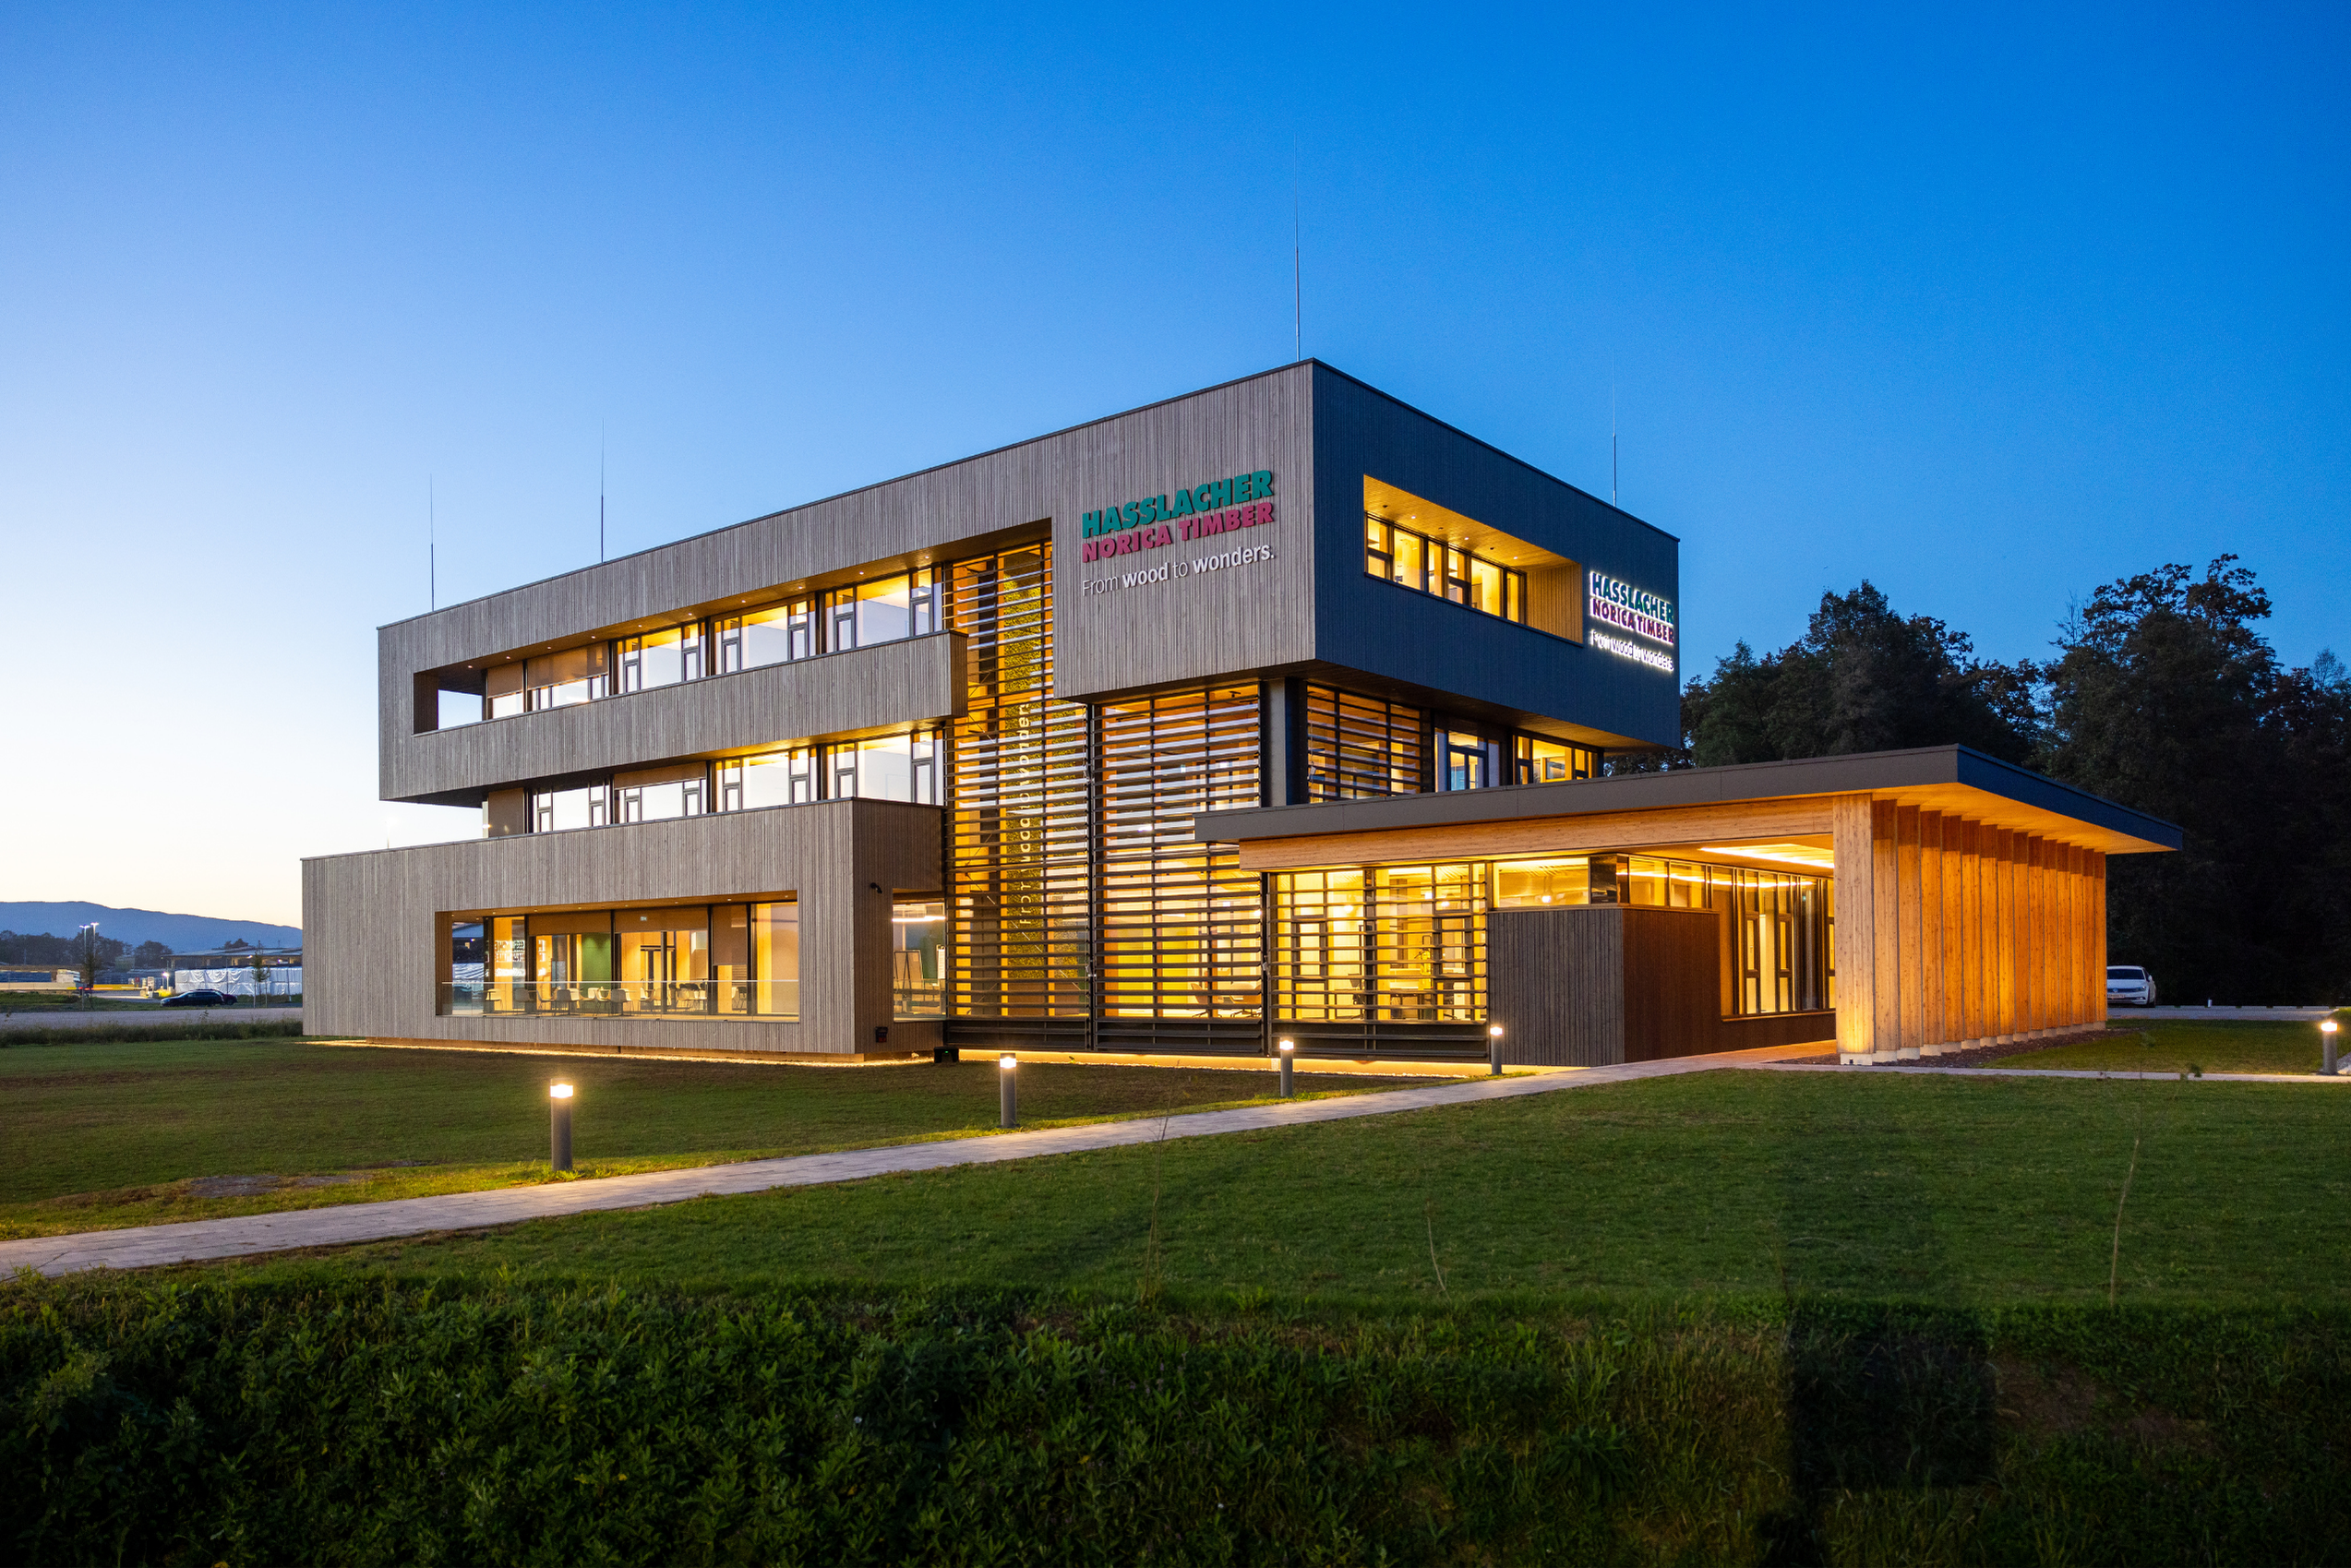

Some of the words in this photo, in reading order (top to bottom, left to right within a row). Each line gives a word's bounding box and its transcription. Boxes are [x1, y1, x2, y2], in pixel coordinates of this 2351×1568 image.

[1082, 470, 1274, 538] HASSLACHER
[1082, 524, 1172, 562] NORICA
[1179, 502, 1274, 541] TIMBER
[1082, 575, 1120, 596] From
[1122, 563, 1169, 588] wood
[1172, 562, 1188, 579] to
[1193, 544, 1276, 574] wonders.
[1589, 570, 1674, 626] HASSLACHER
[1589, 597, 1635, 630] NORICA
[1635, 614, 1674, 645] TIMBER
